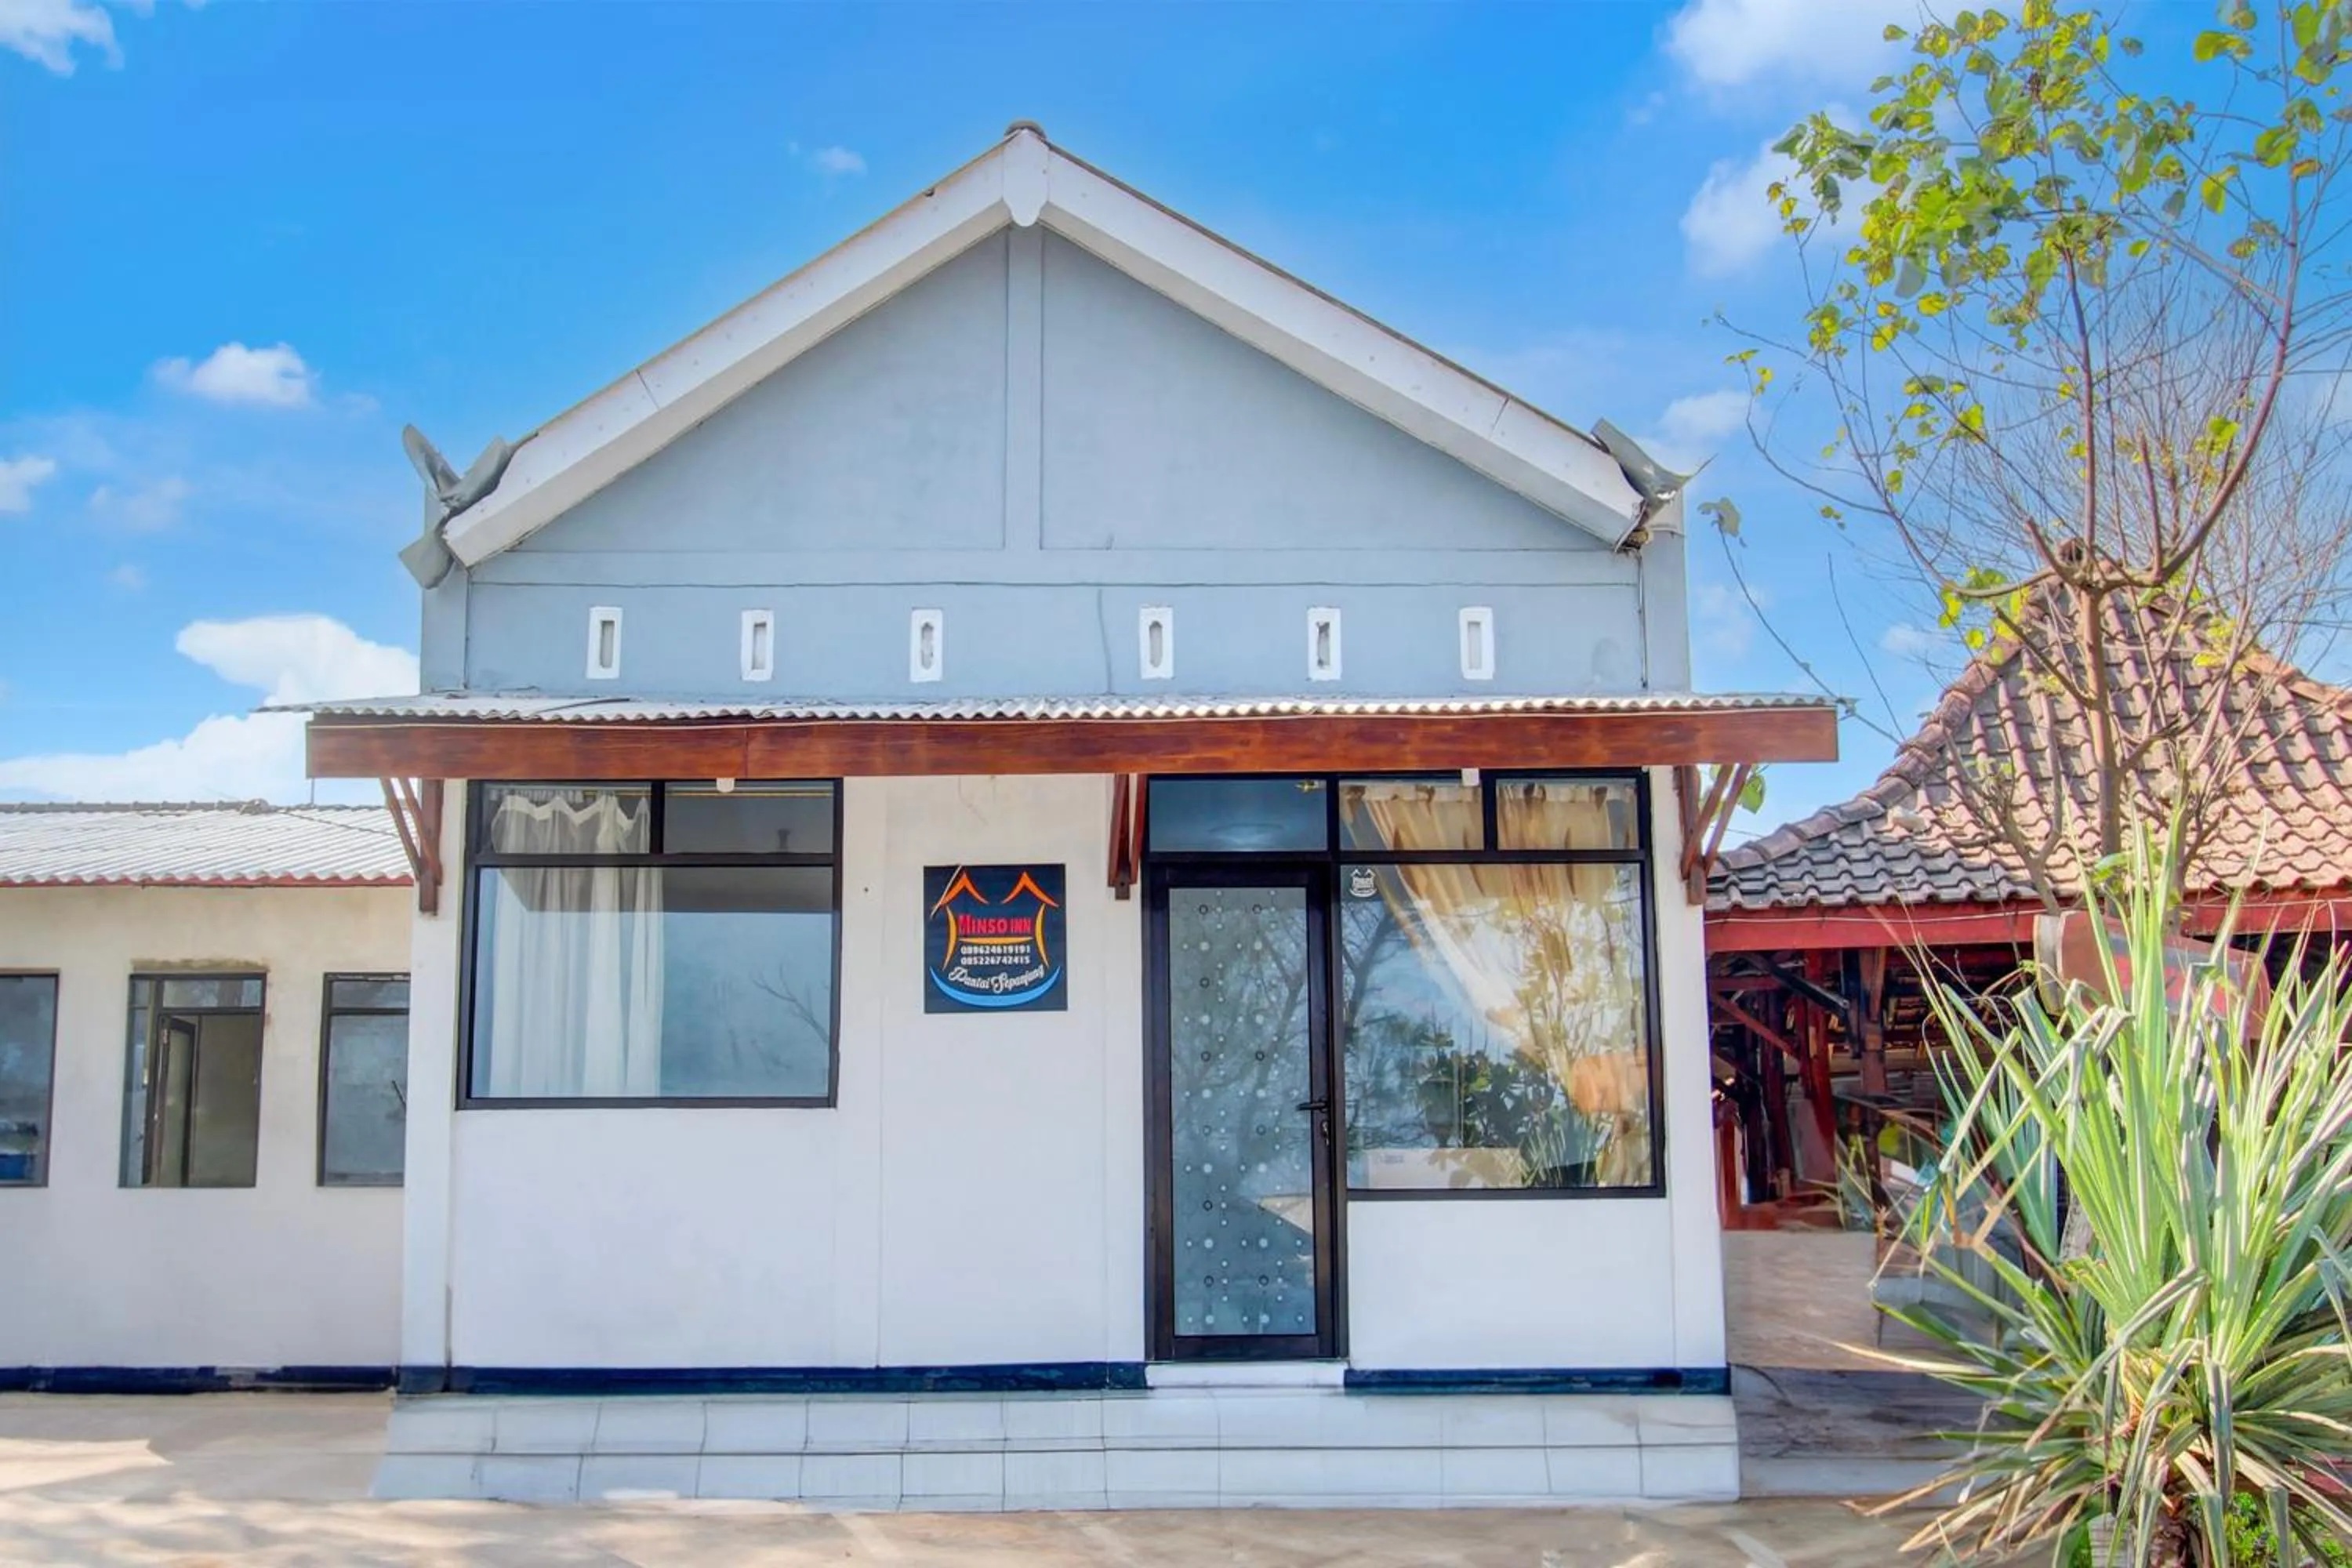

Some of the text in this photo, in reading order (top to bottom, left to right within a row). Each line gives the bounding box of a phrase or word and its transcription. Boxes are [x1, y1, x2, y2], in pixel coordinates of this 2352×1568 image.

[1011, 918, 1031, 933] INN
[948, 964, 1044, 993] Pantai Sepanjang
